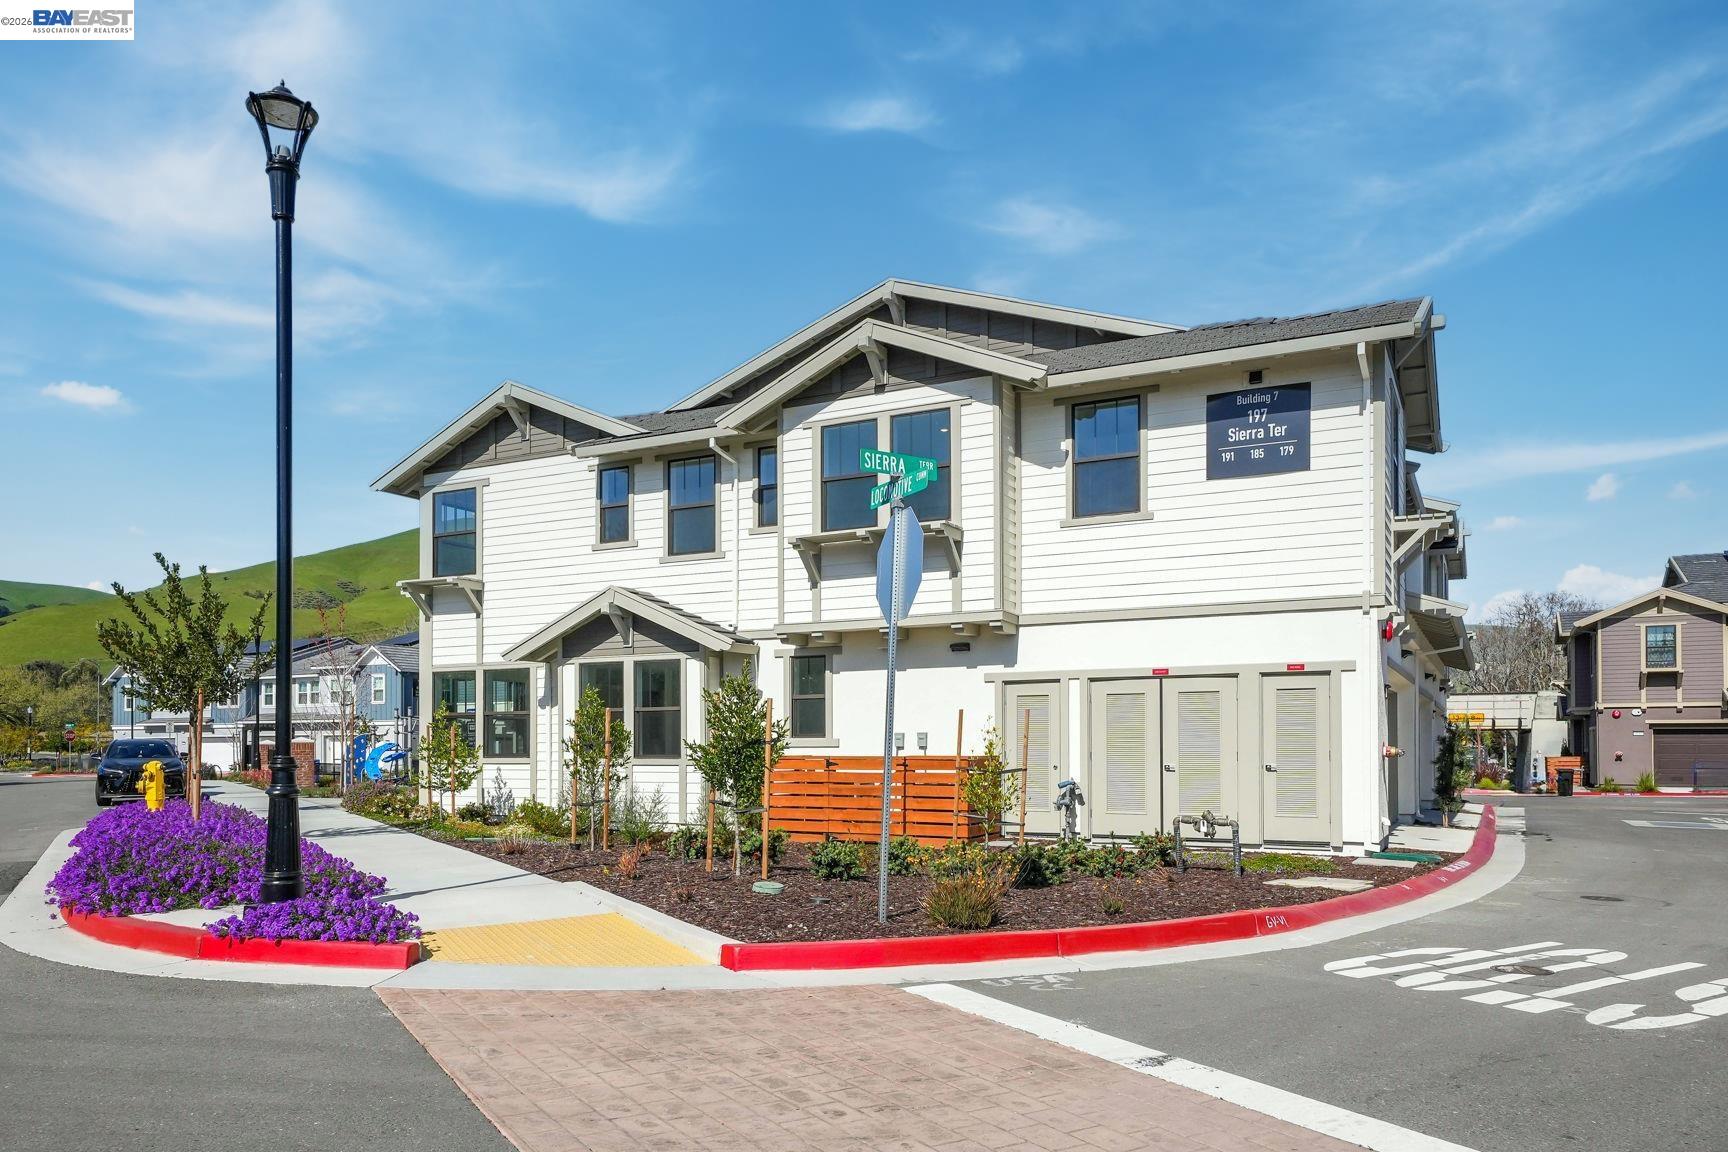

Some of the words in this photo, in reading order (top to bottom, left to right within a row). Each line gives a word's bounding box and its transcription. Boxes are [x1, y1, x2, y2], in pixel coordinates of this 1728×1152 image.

[1236, 393, 1271, 405] Building
[1273, 391, 1279, 401] 7
[1247, 408, 1268, 423] 197
[1228, 427, 1265, 442] Sierra
[1268, 423, 1288, 437] Ter
[1221, 452, 1235, 462] 191
[1250, 448, 1265, 459] 185
[1279, 445, 1295, 456] 179
[864, 452, 906, 474] SIERRA
